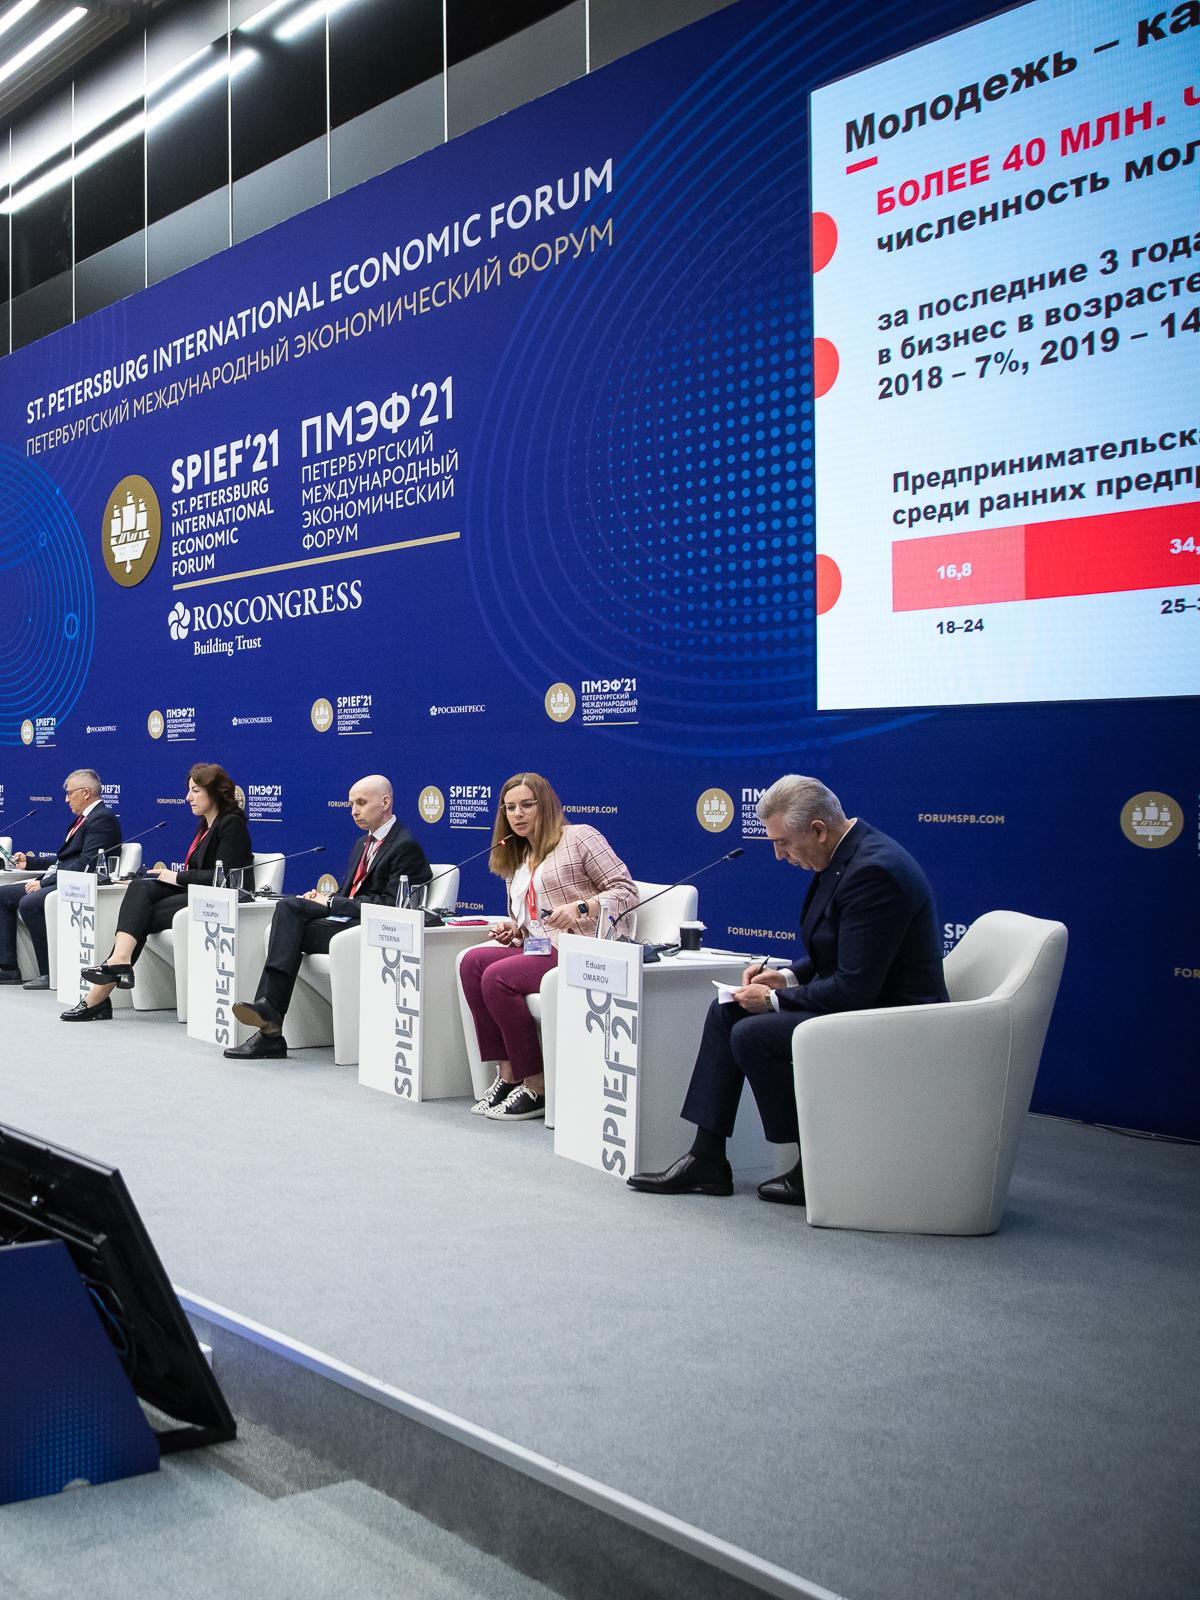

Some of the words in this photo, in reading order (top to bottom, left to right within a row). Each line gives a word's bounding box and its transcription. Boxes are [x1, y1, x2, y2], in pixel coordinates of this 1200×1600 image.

[845, 50, 1078, 154] Молодежь
[877, 155, 990, 215] БОЛЕЕ
[1003, 138, 1046, 172] 40
[1060, 100, 1166, 157] МЛН.
[877, 172, 1110, 253] численность
[26, 401, 47, 424] ST.
[48, 354, 149, 418] PETERSBURG
[152, 289, 325, 372] INTERNATIONAL
[330, 213, 481, 302] ECONOMIC
[489, 158, 613, 239] FORUM
[877, 307, 909, 332] за
[918, 263, 1088, 322] последние
[1100, 249, 1119, 276] 3
[26, 402, 130, 457] ПЕТЕРБУРГСКИЙ
[133, 337, 290, 419] МЕЖДУНАРОДНЫЙ
[294, 256, 501, 359] ЭКОНОМИЧЕСКИЙ
[508, 219, 613, 280] ФОРУМ
[878, 346, 892, 365] в
[901, 321, 1007, 361] бизнес
[1018, 312, 1034, 333] в
[878, 365, 943, 400] 2018
[975, 349, 1029, 380] 7%,
[1040, 326, 1120, 366] 2019
[301, 431, 434, 484] ПЕТЕРБУРГСКИЙ
[302, 448, 459, 506] МЕЖДУНАРОДНЫЙ
[892, 427, 1200, 497] Предпринимательск
[171, 501, 188, 517] ST.
[189, 477, 269, 513] PETERSBURG
[302, 475, 454, 529] ЭКОНОМИЧЕСКИЙ
[892, 499, 969, 528] среди
[980, 483, 1085, 518] ранних
[171, 498, 275, 537] INTERNATIONAL
[171, 527, 239, 557] ECONOMIC
[302, 524, 358, 551] ФОРУМ
[172, 553, 215, 578] FORUM
[936, 562, 973, 582] 16,8
[193, 579, 363, 632] ROSCONGRESS
[193, 639, 234, 657] Building
[235, 635, 262, 652] Trust
[438, 705, 485, 714] РОСКОНГРЕСС
[582, 692, 629, 700] ПЕТЕРБУРГСКИЙ
[582, 699, 638, 707] МЕЖДУНАРОДНЫЙ
[582, 706, 636, 714] ЭКОНОМИЧЕСКИЙ
[101, 784, 120, 794] PIEF'21
[562, 805, 618, 813] FORUMSPB.COM
[918, 813, 1004, 824] FORUMSPB.COM
[83, 905, 94, 931] 21
[727, 926, 796, 941] FORUMSPB.COM
[220, 926, 235, 956] 21
[401, 954, 420, 991] 21
[582, 972, 609, 984] OMAROV
[585, 960, 606, 971] Eduard
[216, 962, 234, 1045] SPIEF
[611, 997, 637, 1044] 21
[395, 998, 419, 1098] SPIEF
[602, 1051, 636, 1176] SPIEF
